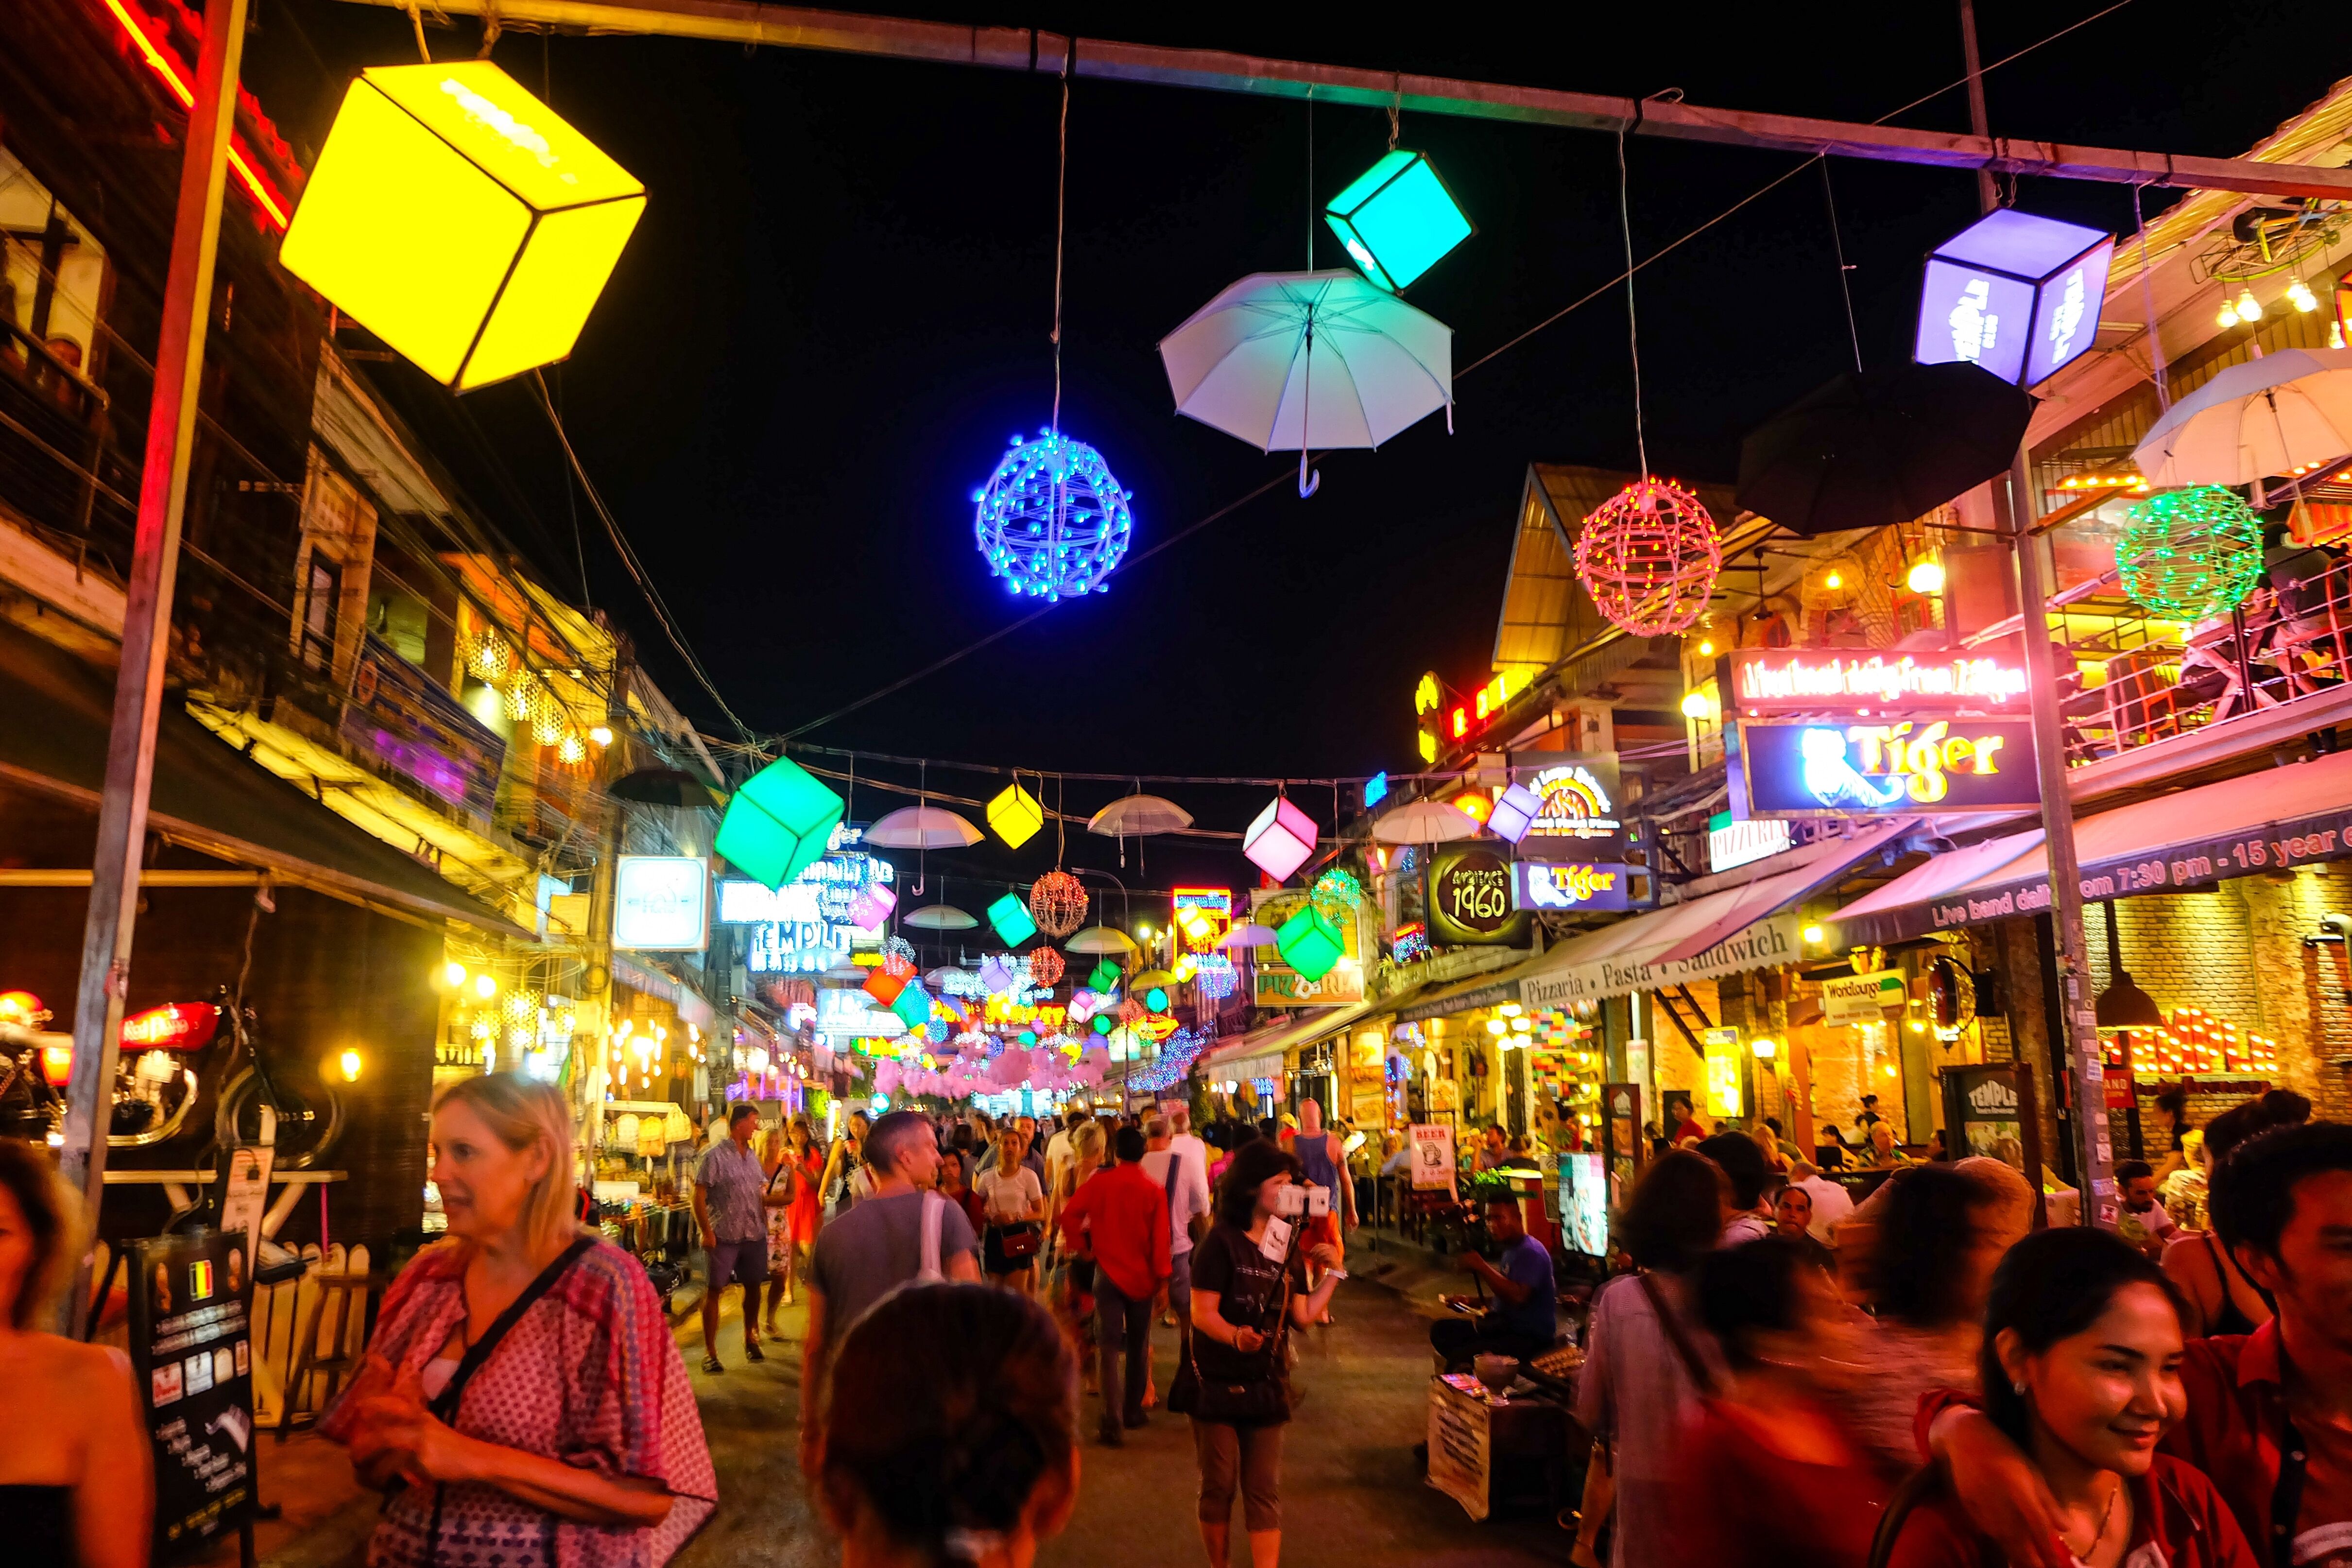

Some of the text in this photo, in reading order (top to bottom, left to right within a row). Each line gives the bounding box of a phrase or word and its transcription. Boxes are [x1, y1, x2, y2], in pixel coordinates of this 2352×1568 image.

[1848, 721, 2004, 803] Tiger
[1550, 864, 1616, 901] Tiger
[1932, 901, 1966, 929] Live
[1967, 891, 2014, 922] band
[2016, 883, 2051, 912] dail
[2118, 859, 2166, 891] 7:30
[2172, 854, 2213, 887] pm
[2232, 839, 2268, 870] 15
[2269, 829, 2337, 868] year
[1453, 884, 1505, 919] 1960
[1526, 973, 1584, 1004] Pizzaria
[1602, 961, 1652, 988] Pasta
[1968, 1080, 2019, 1107] TEMPLE
[1416, 1129, 1445, 1140] BEER
